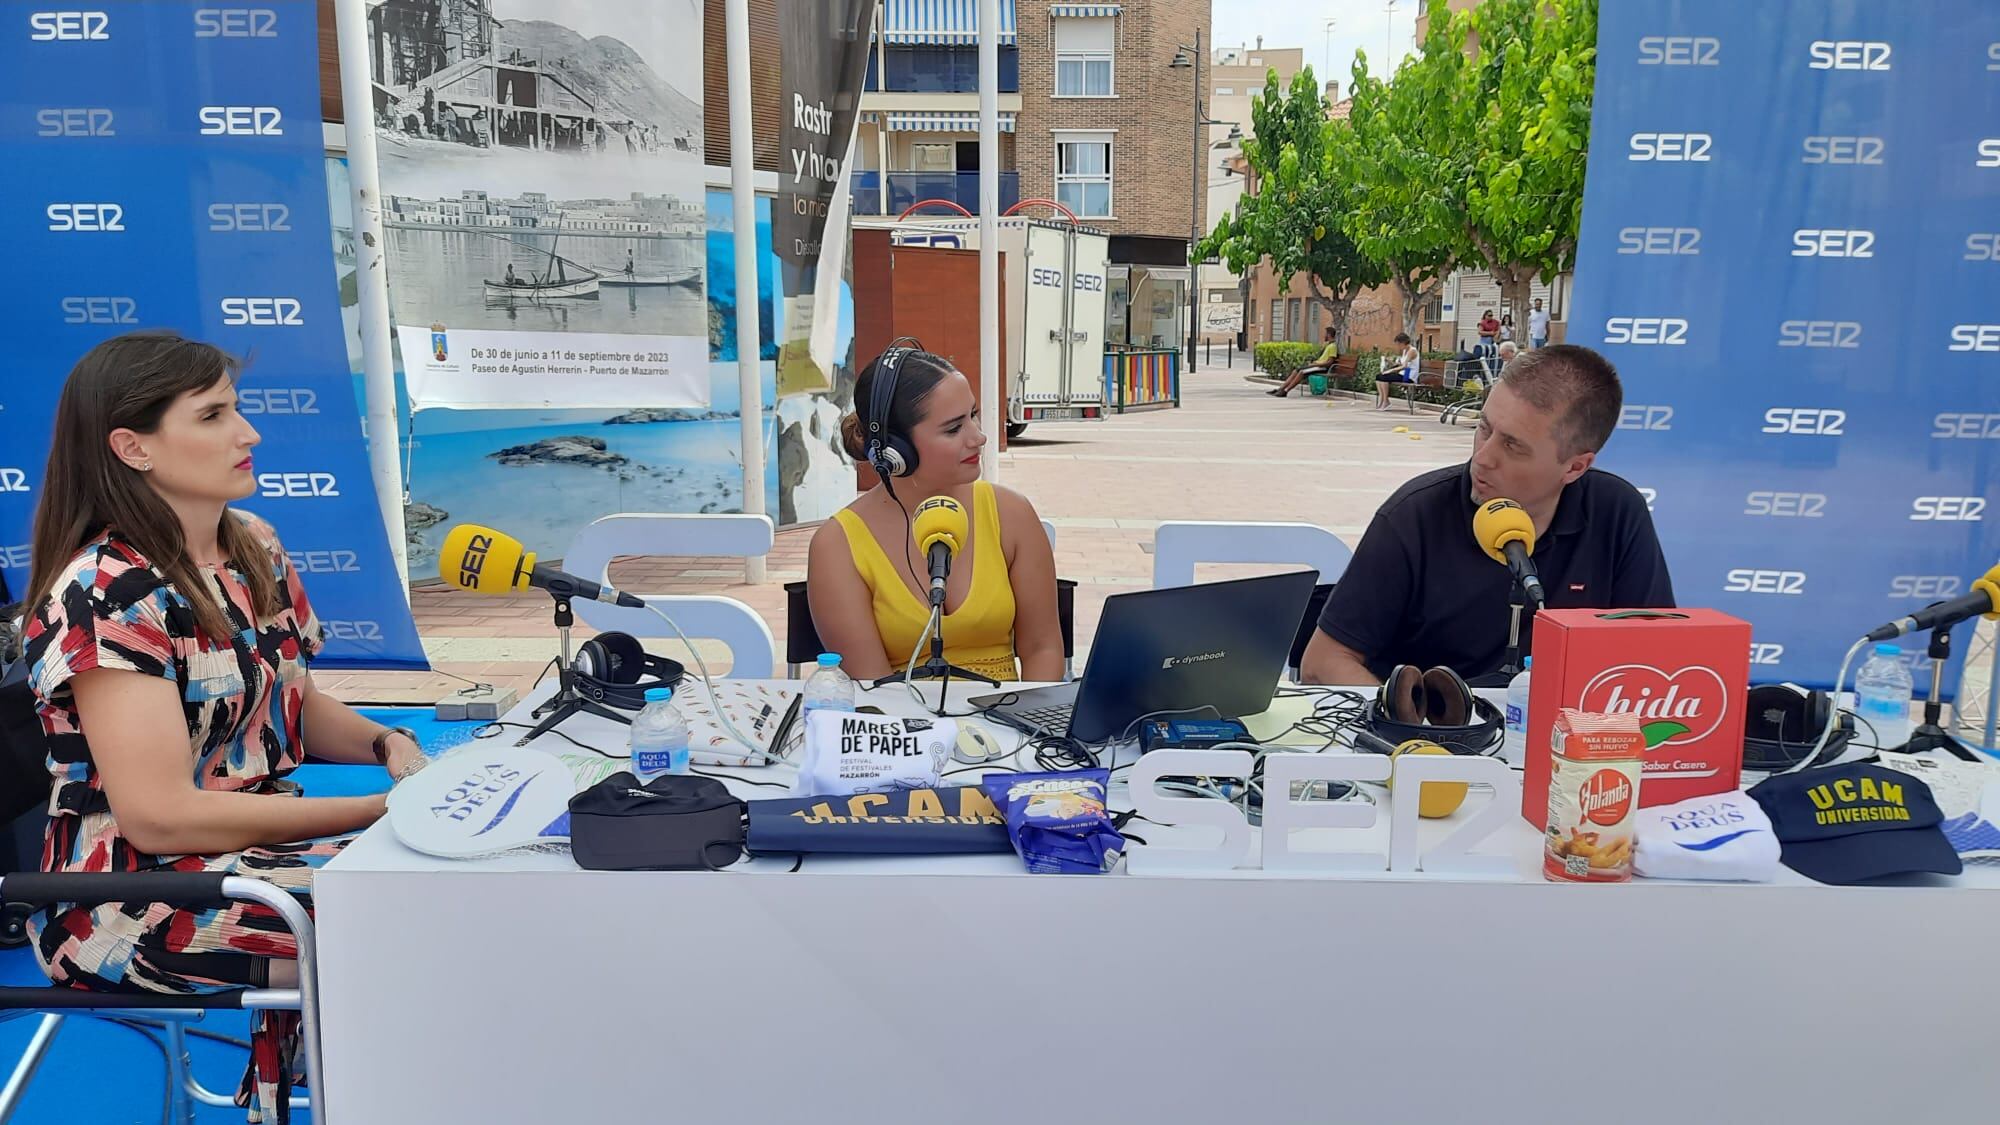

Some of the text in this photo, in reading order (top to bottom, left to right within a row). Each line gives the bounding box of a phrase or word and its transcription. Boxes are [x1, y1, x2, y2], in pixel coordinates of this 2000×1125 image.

[31, 11, 109, 41] SER
[194, 8, 278, 38] SER
[1638, 37, 1720, 66] SER
[1809, 41, 1892, 71] SER
[37, 108, 115, 137] SER
[199, 106, 283, 135] SER
[794, 93, 833, 136] Rastr
[1629, 133, 1712, 162] SER
[1802, 137, 1884, 165] SER
[792, 149, 807, 183] y
[47, 203, 125, 232] SER
[207, 203, 292, 232] SER
[1617, 227, 1700, 255] SER
[1792, 230, 1874, 258] SER
[1033, 268, 1061, 288] SER
[1074, 274, 1102, 291] SER
[61, 296, 139, 325] SER
[221, 298, 304, 326] SER
[1604, 318, 1688, 345] SER
[1778, 320, 1862, 348] SER
[1949, 325, 2000, 351] SE
[471, 348, 669, 364] De 30 de junio a 11 de septiembre de 2023
[472, 364, 497, 374] Paseo
[499, 364, 510, 374] de
[589, 366, 617, 376] Puerto
[619, 366, 630, 375] de
[238, 388, 320, 414] SER
[1616, 405, 1673, 430] ER
[1762, 408, 1846, 435] SER
[258, 472, 340, 497] SER
[1744, 491, 1827, 517] SER
[1910, 497, 1986, 521] SER
[460, 534, 492, 590] SER
[1724, 569, 1806, 594] SER
[1888, 576, 1962, 598] SER
[1182, 651, 1226, 664] dynabook
[842, 718, 900, 736] MARES
[842, 736, 923, 756] DE PAPEL
[1642, 760, 1707, 770] Sabor Casero
[430, 764, 504, 818] AQUA
[448, 769, 520, 822] DEUS
[1808, 778, 1904, 810] UCAM
[1127, 748, 1521, 875] SER
[1816, 807, 1910, 825] UNIVERSIDAD
